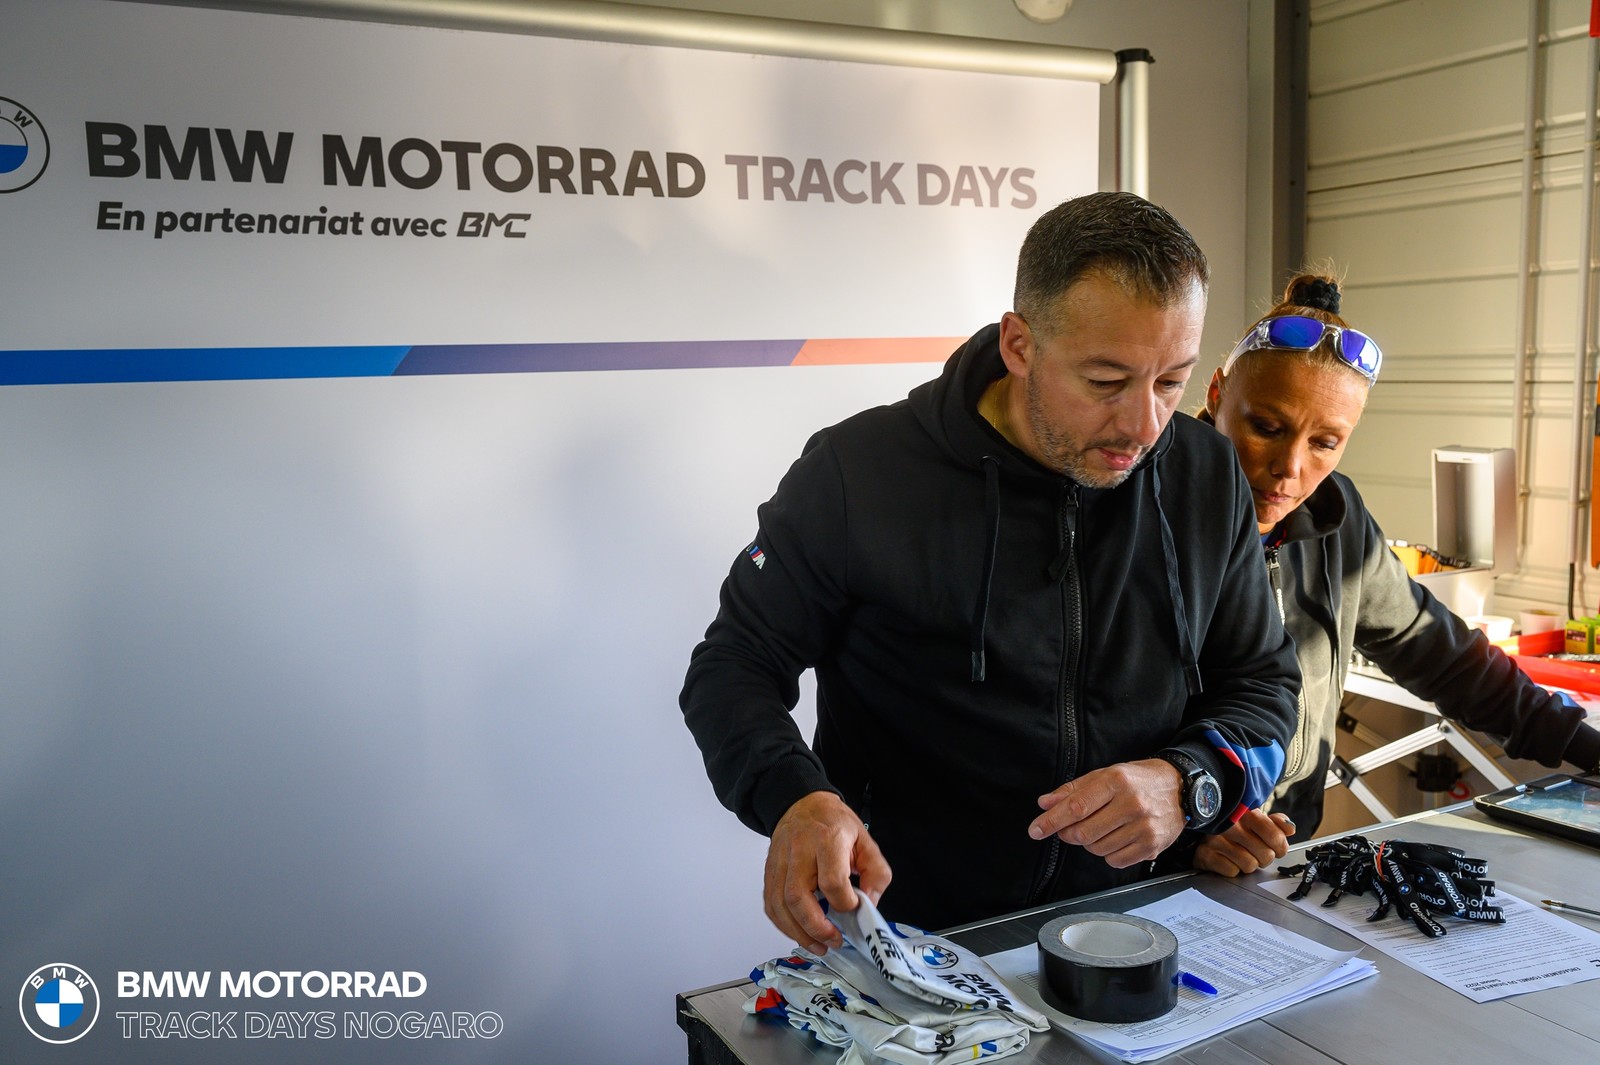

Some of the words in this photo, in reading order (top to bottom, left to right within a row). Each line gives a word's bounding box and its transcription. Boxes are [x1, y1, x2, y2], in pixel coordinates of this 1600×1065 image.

[85, 121, 294, 184] BMW
[322, 134, 706, 199] MOTORRAD
[724, 154, 906, 206] TRACK
[916, 163, 1038, 210] DAYS
[96, 201, 145, 231] En
[154, 205, 364, 239] partenariat
[371, 217, 448, 238] avec
[456, 212, 532, 239] BMC
[1469, 911, 1497, 920] BMW
